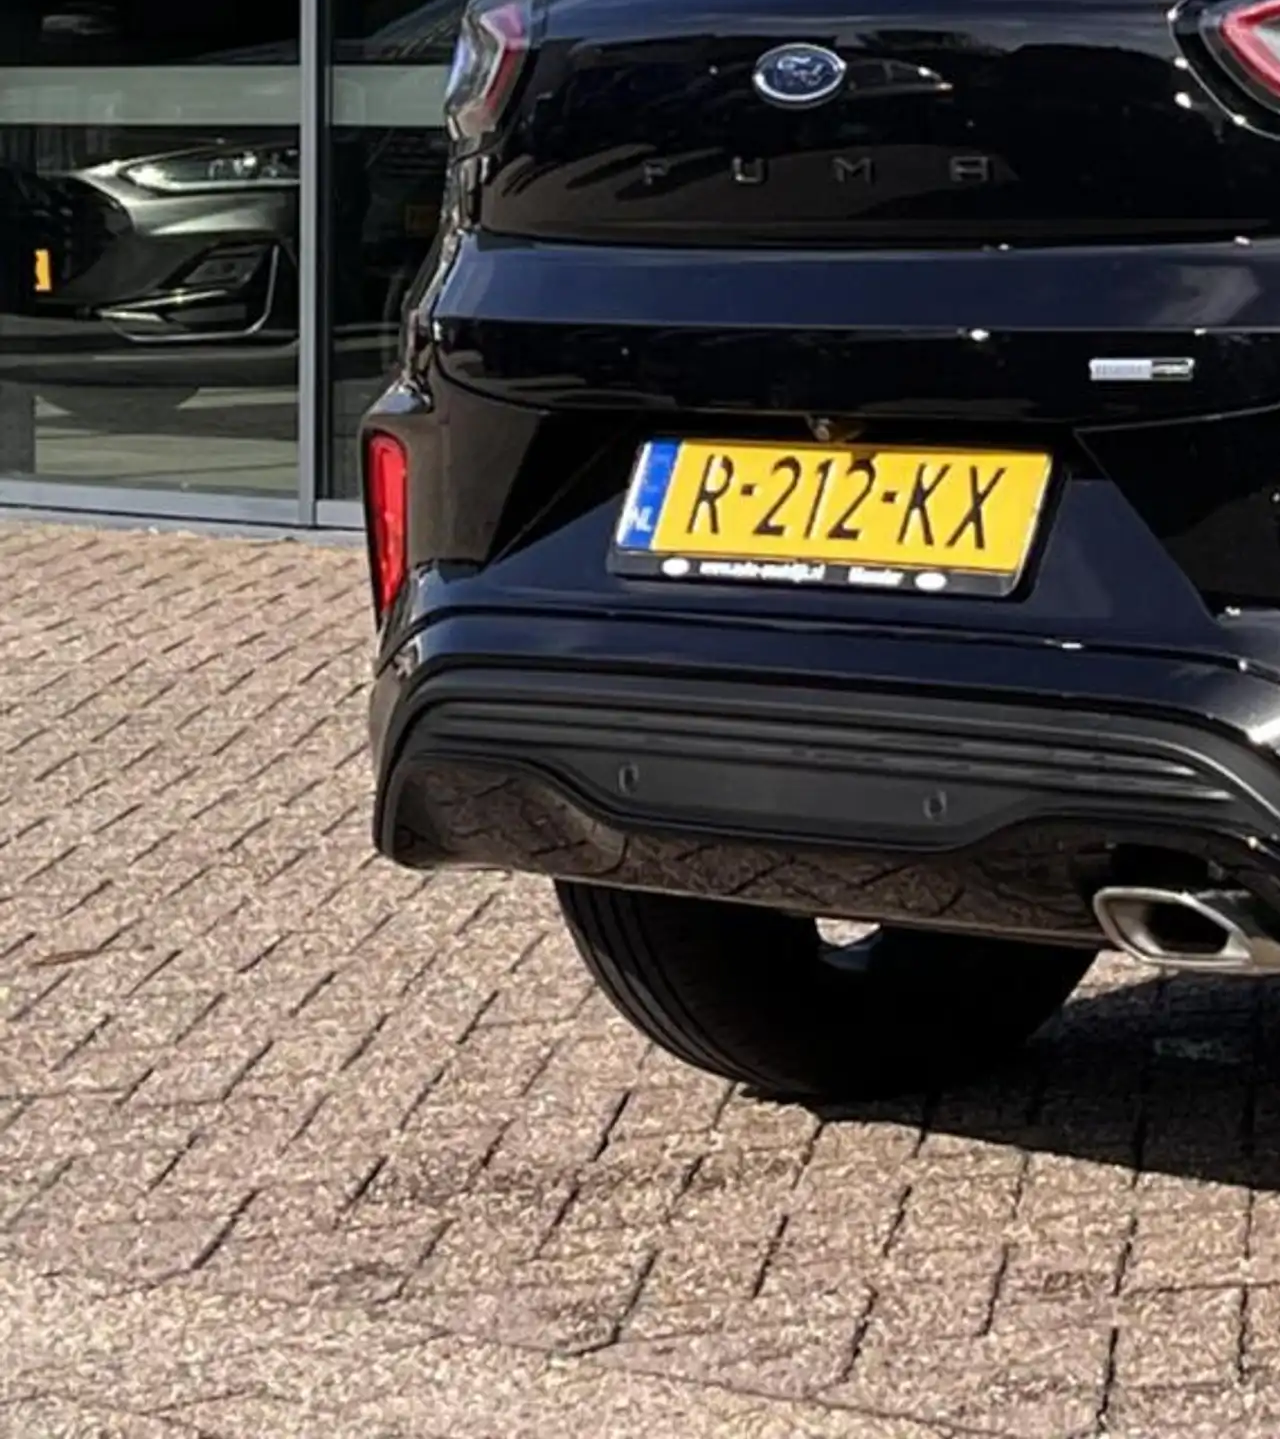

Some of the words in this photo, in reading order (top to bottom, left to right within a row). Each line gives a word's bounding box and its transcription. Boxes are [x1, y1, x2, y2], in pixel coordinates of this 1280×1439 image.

[642, 154, 990, 186] PUMA
[685, 453, 1008, 551] R-212-KX
[623, 504, 653, 533] NL
